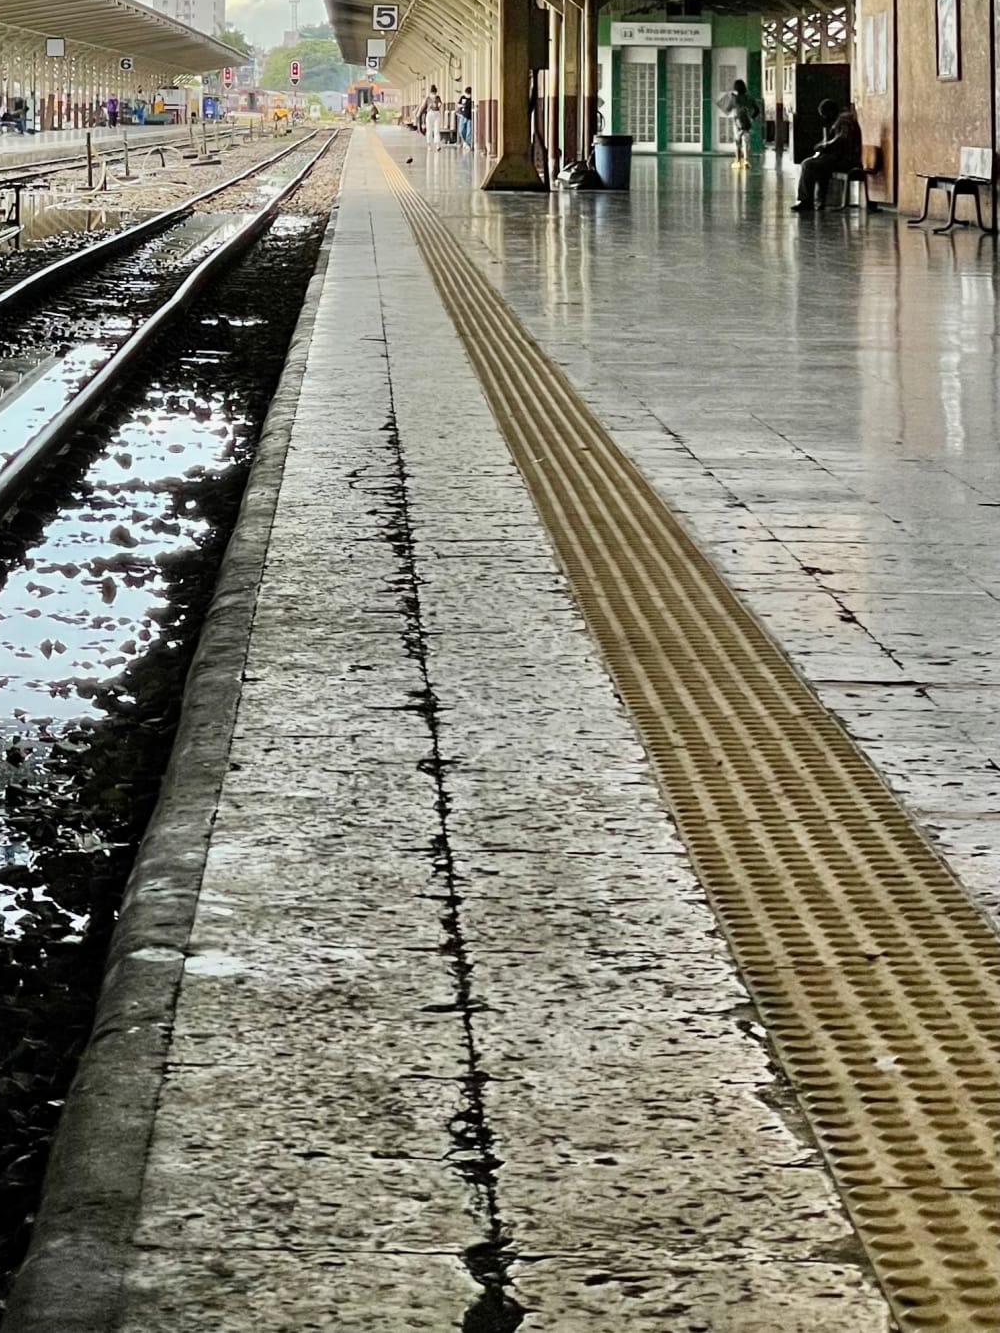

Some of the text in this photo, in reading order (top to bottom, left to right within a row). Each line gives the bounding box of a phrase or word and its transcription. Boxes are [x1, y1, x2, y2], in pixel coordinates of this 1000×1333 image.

[376, 7, 396, 29] 5
[120, 58, 132, 70] 6
[367, 57, 378, 68] 5
